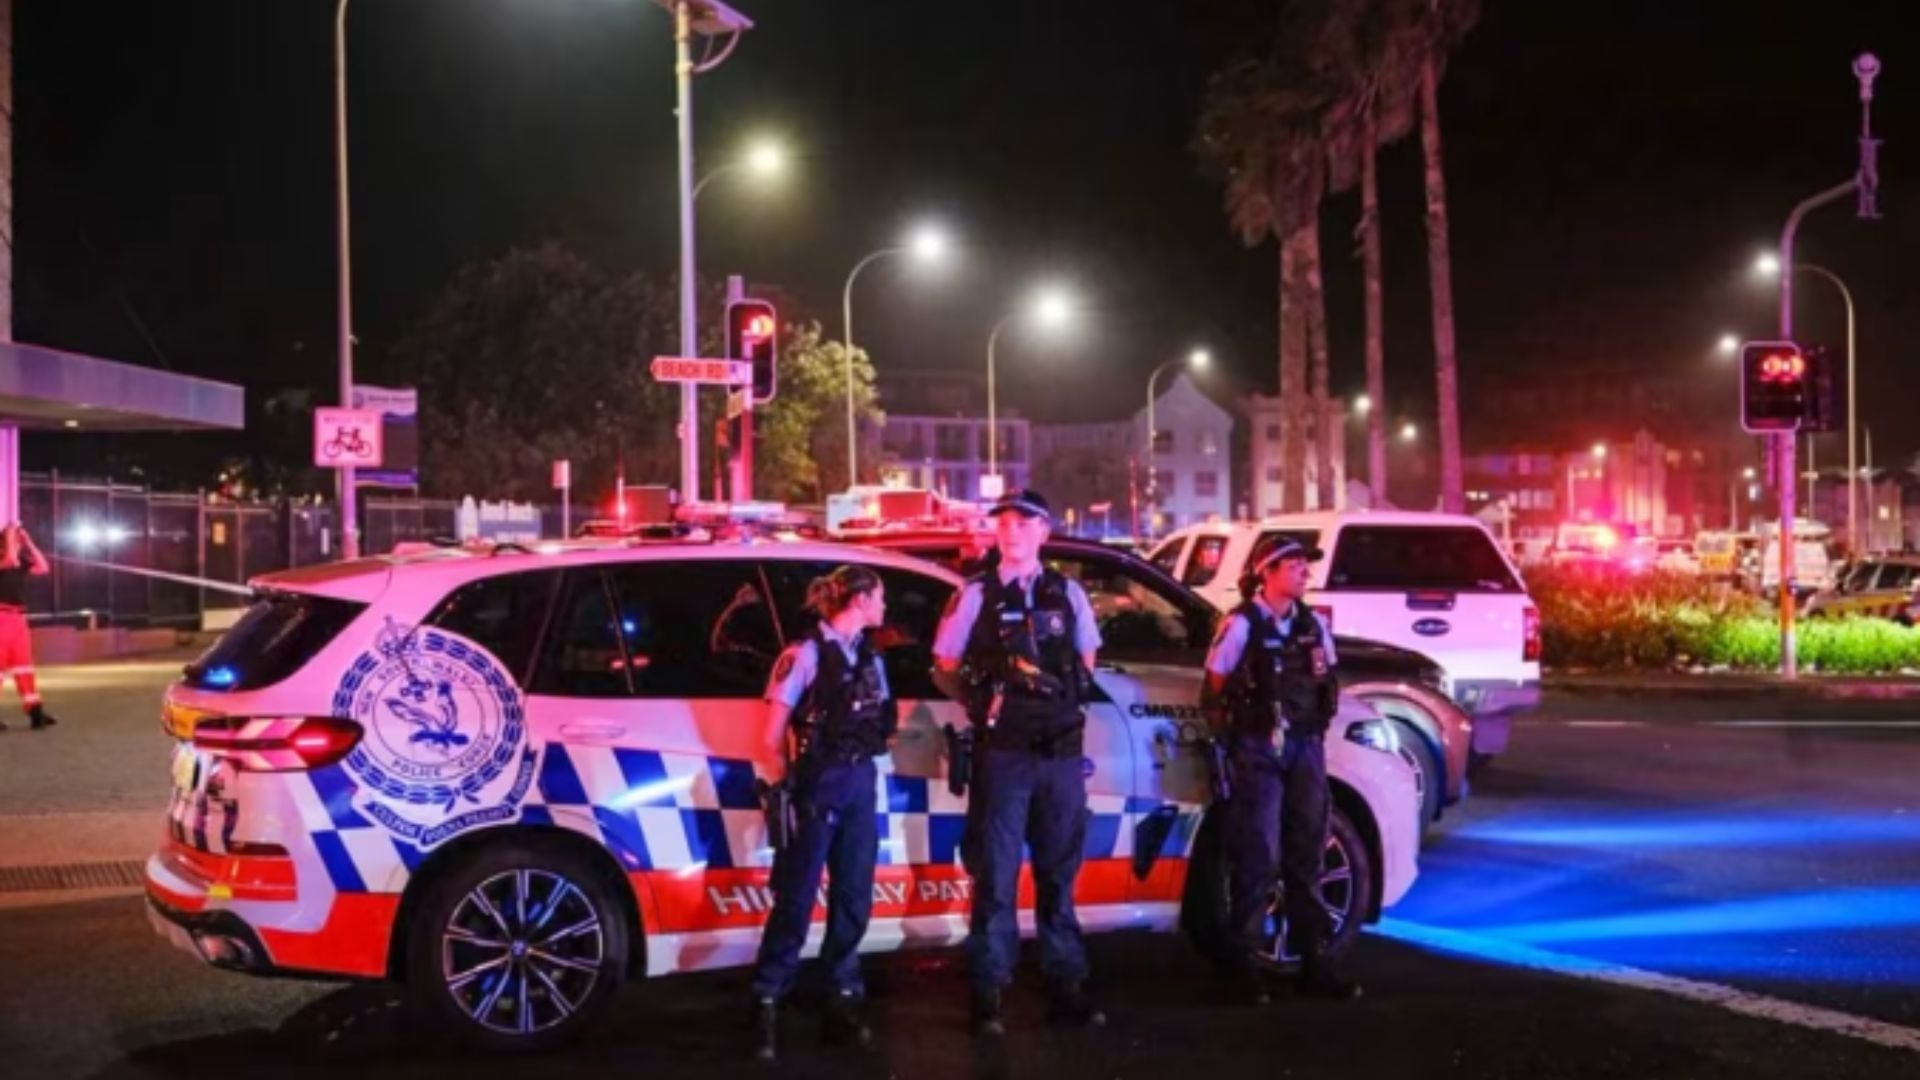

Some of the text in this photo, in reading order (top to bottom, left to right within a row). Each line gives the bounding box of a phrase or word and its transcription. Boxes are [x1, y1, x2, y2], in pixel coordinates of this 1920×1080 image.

[660, 361, 724, 380] BEACH RD
[1129, 704, 1200, 719] CMB22
[391, 758, 442, 778] POLICE
[708, 878, 974, 915] HIAY PAT
